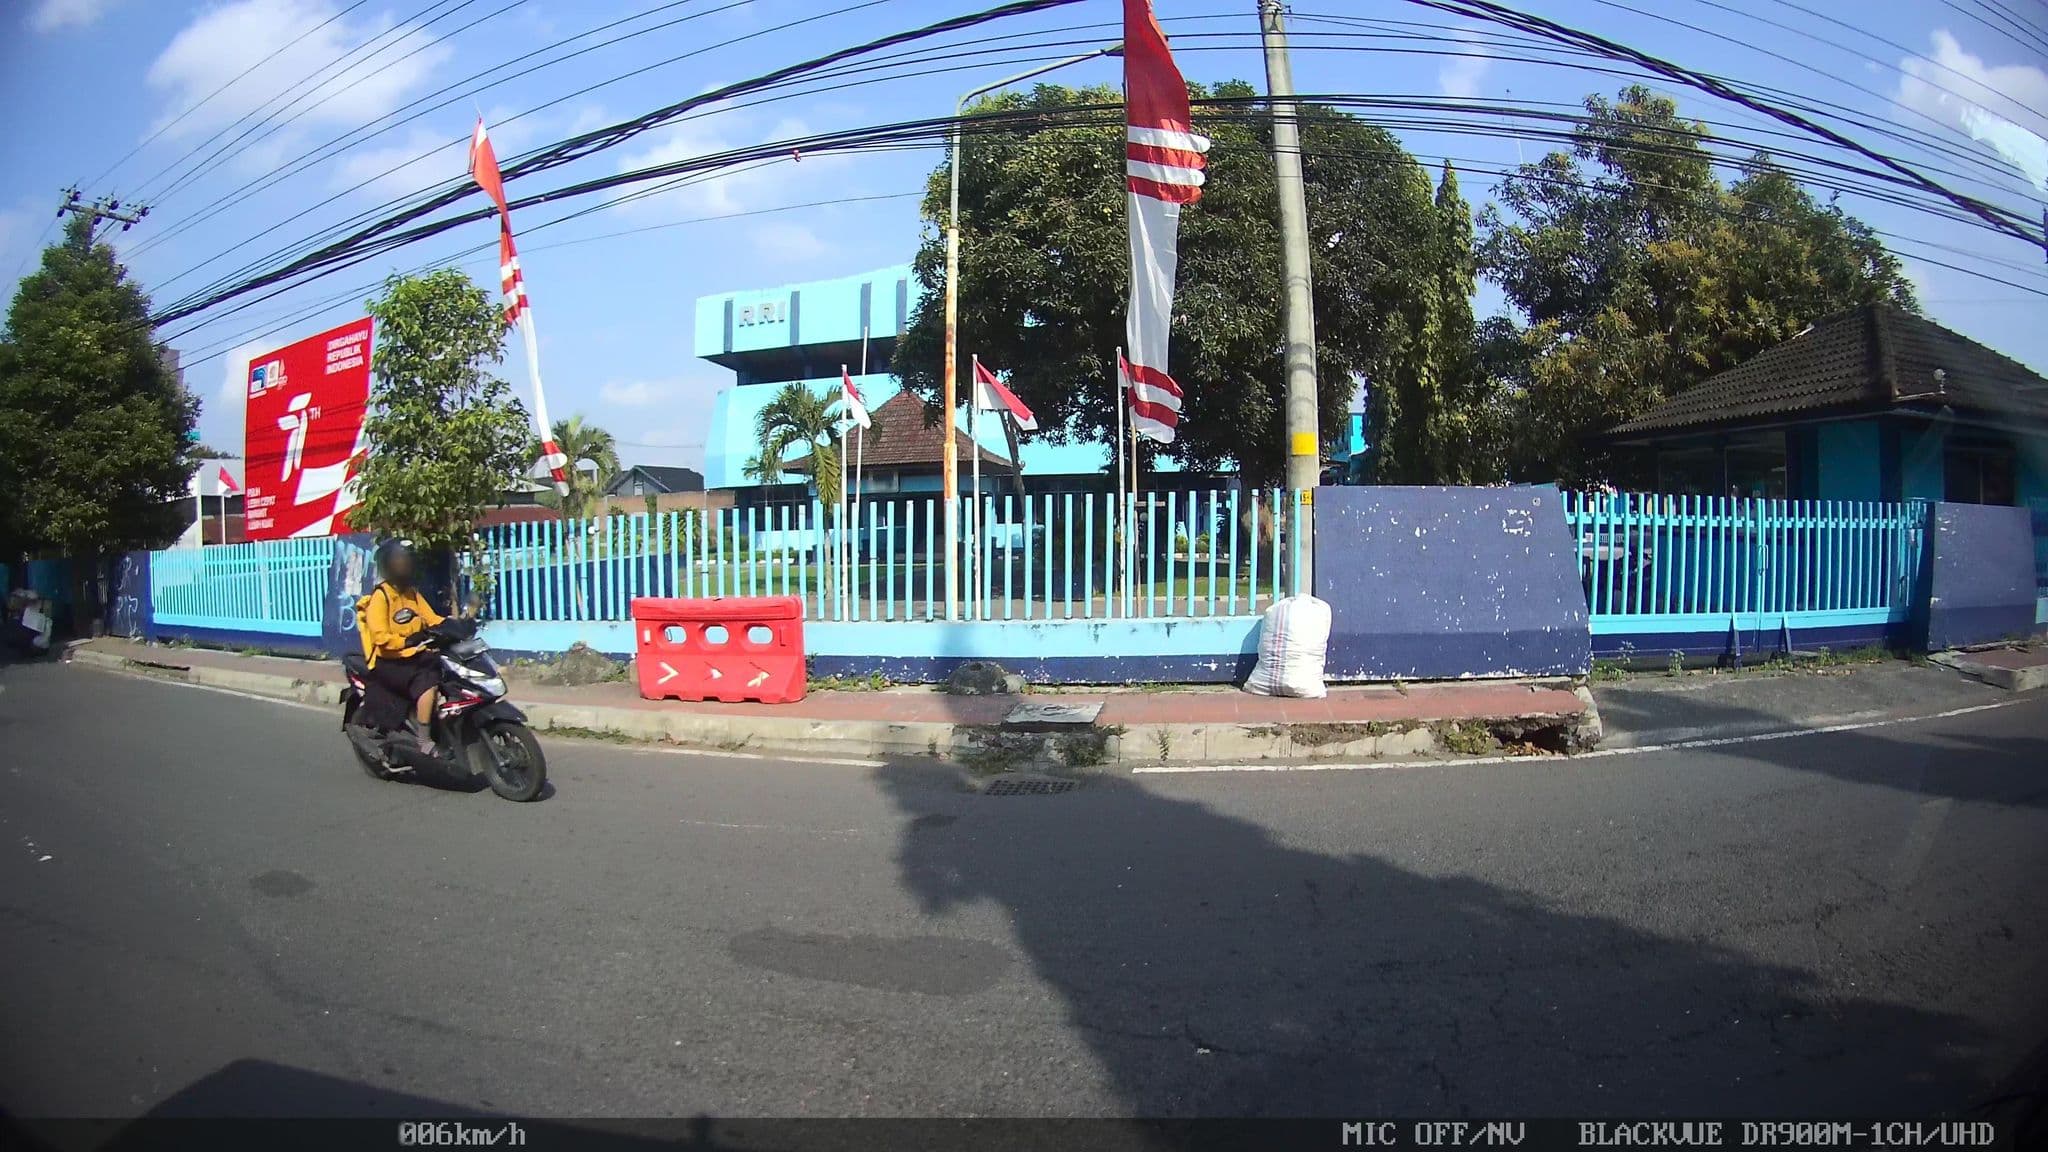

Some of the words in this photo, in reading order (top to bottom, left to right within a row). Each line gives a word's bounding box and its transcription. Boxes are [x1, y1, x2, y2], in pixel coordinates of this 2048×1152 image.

[739, 302, 786, 328] RRI
[326, 329, 369, 352] DIRGAHAYU
[326, 343, 362, 364] REPUBLIK
[325, 354, 364, 375] INDONESIA
[309, 405, 321, 421] TH
